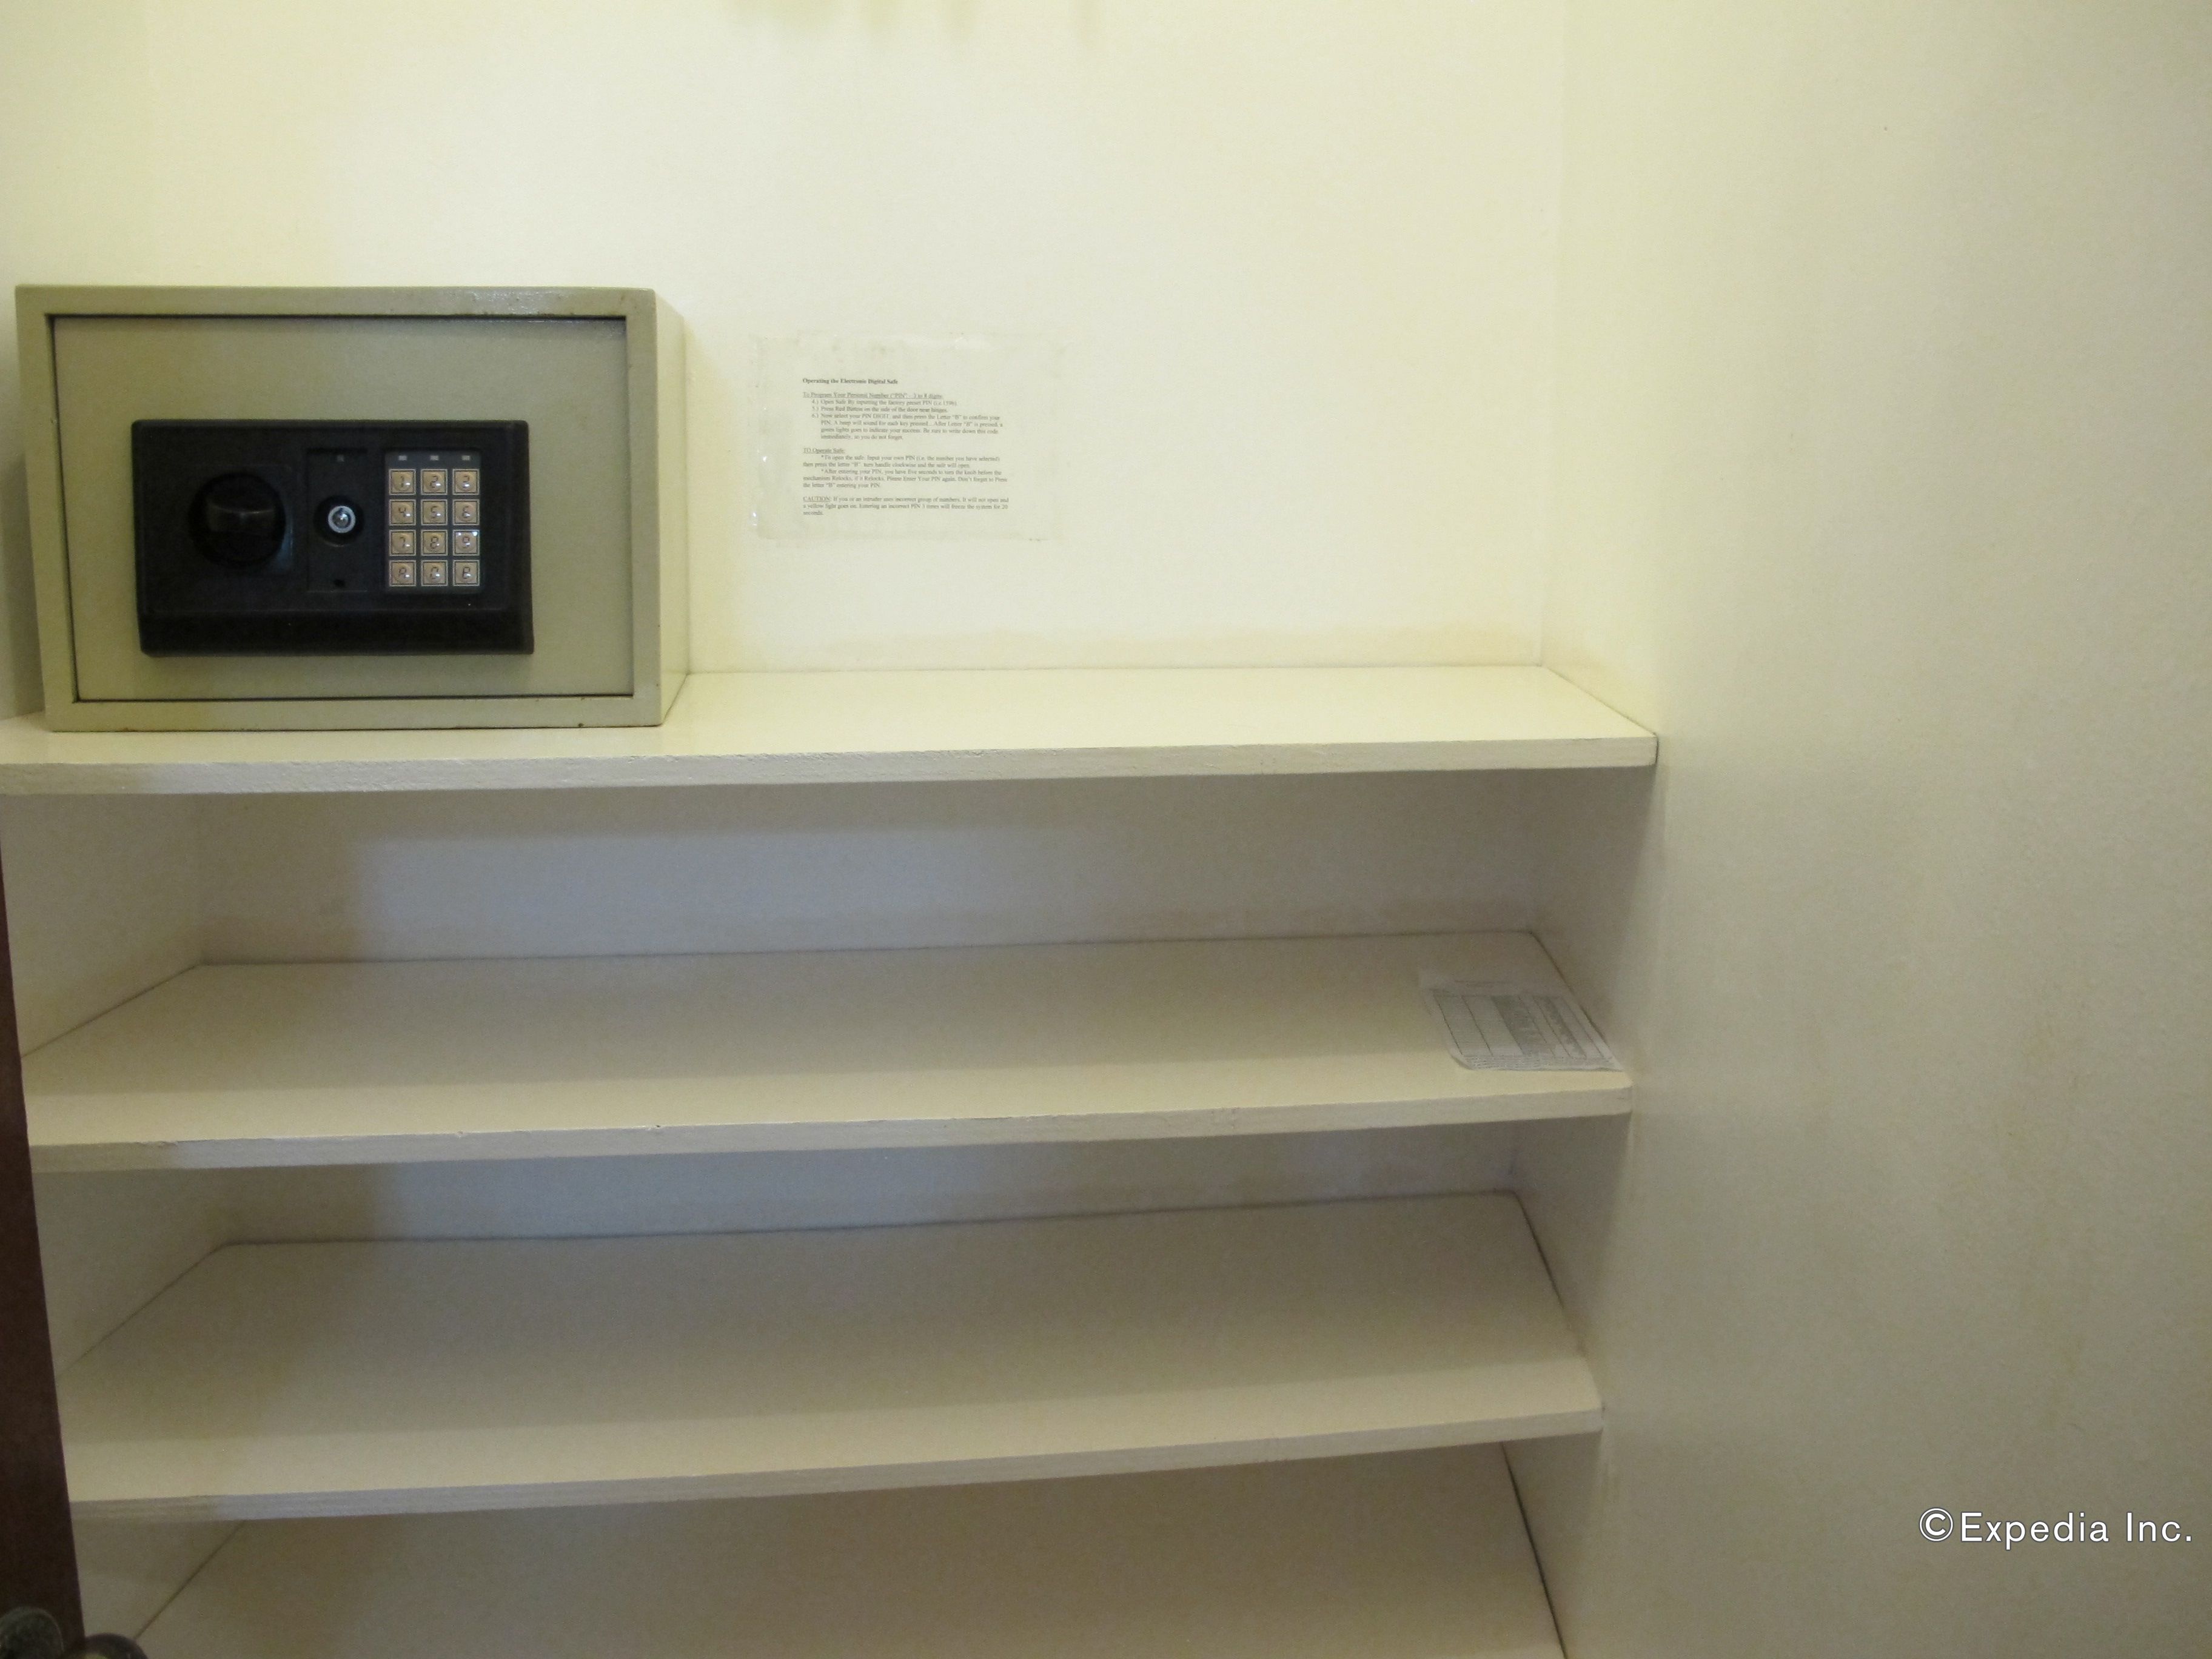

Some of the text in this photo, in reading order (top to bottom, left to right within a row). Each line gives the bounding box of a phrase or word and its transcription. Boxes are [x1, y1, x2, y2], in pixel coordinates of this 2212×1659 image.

[400, 475, 471, 489] 1 2 3
[398, 506, 407, 518] 4
[430, 505, 439, 519] 5
[399, 535, 471, 550] 7 8 9
